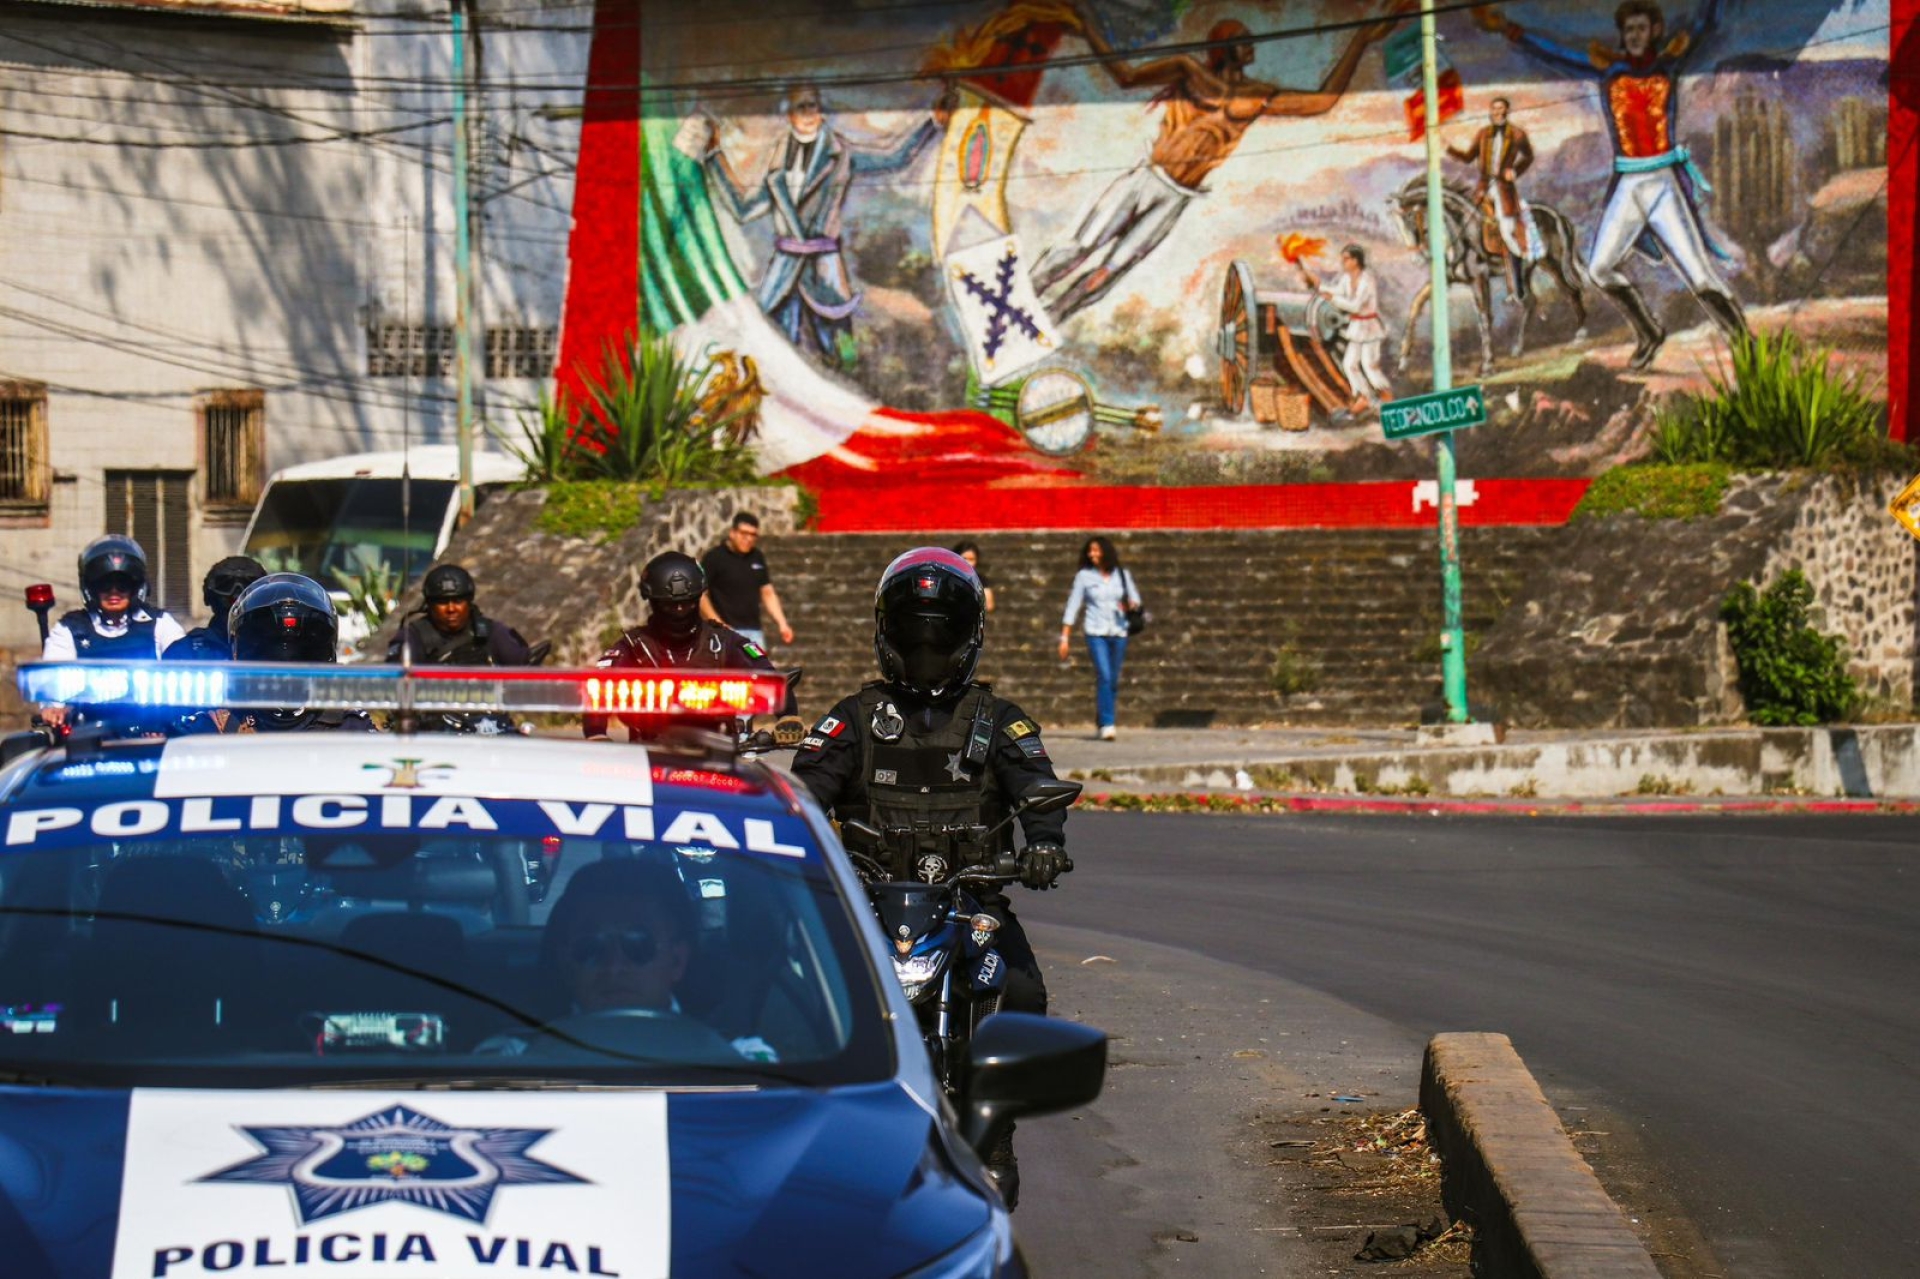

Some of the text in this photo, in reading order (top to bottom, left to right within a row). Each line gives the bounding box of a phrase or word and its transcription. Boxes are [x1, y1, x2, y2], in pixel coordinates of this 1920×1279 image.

[6, 795, 806, 858] POLICIA VIAL
[152, 1233, 619, 1279] POLICIA VIAL
